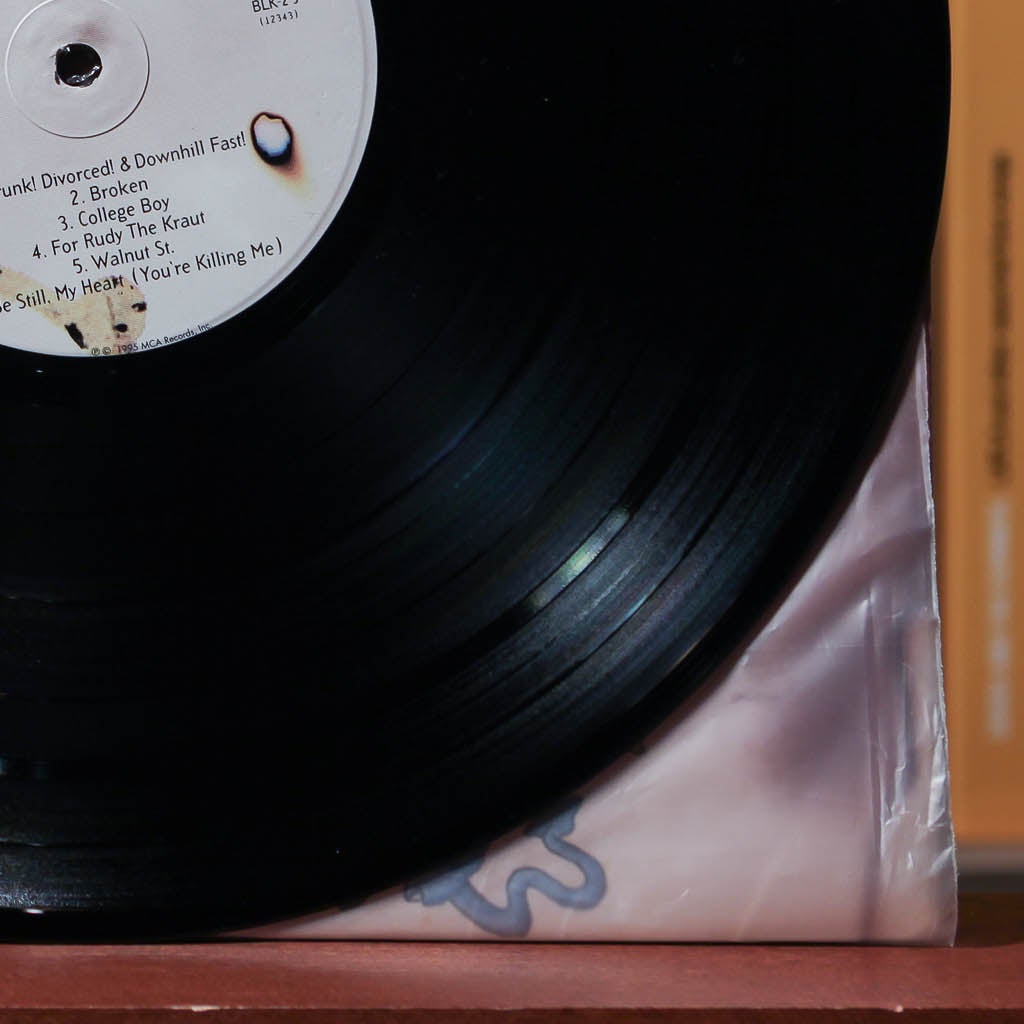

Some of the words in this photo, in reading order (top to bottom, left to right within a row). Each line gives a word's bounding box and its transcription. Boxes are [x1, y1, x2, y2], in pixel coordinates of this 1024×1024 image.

[41, 159, 115, 188] Divorced!
[120, 157, 132, 172] &
[134, 140, 205, 169] Downhill
[210, 131, 247, 153] Fast!
[70, 190, 86, 206] 2.
[90, 179, 149, 202] Broken
[57, 215, 75, 231] 3.
[78, 201, 136, 228] College
[141, 196, 171, 216] Boy
[32, 244, 48, 260] 4.
[51, 239, 79, 257] For
[83, 228, 124, 250] Rudy
[126, 221, 157, 239] The
[162, 210, 207, 233] Kraut
[55, 282, 77, 302] My
[81, 272, 126, 296] Heart
[132, 260, 192, 284] (You're
[196, 247, 246, 269] Killing
[251, 236, 283, 257] Me)
[72, 258, 89, 274] 5.
[91, 247, 151, 269] Walnut
[156, 240, 176, 257] St.
[141, 338, 163, 350] MCA
